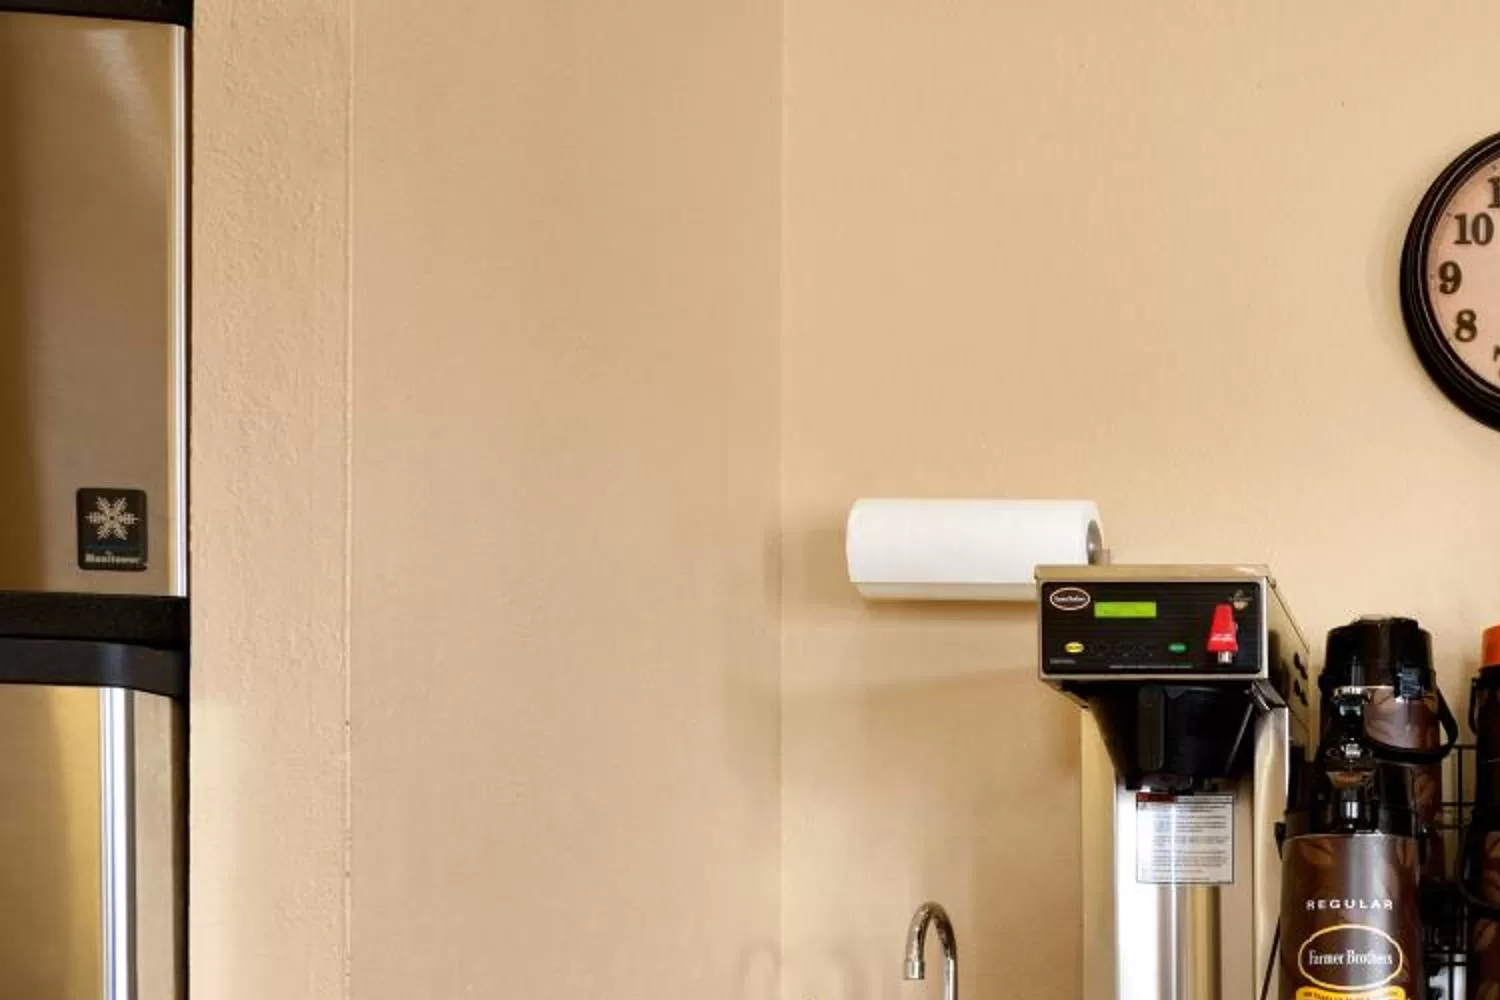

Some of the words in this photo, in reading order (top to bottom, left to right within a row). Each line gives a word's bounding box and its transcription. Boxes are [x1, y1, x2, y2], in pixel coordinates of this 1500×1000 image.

[1454, 212, 1494, 246] 10
[1439, 261, 1462, 295] 9
[1455, 309, 1477, 343] 8
[1306, 899, 1393, 910] REGULAR
[1308, 949, 1344, 965] Farmer
[1346, 949, 1393, 965] Brothers
